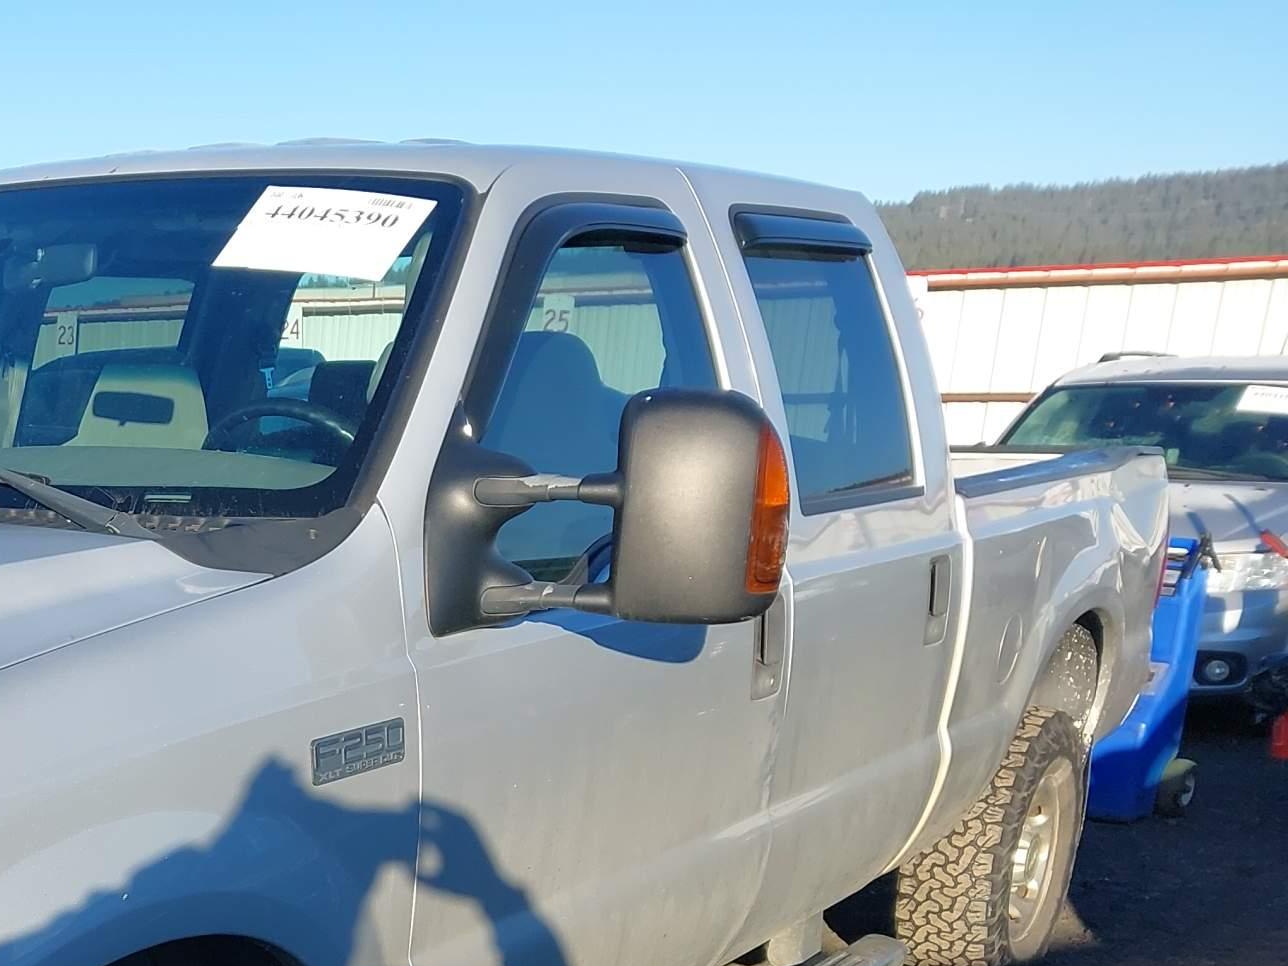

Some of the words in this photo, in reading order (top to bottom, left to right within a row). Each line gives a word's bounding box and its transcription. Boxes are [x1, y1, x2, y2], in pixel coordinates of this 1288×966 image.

[264, 204, 400, 229] 44045390
[543, 309, 571, 332] 25
[57, 325, 75, 345] 23
[318, 767, 343, 783] XLT
